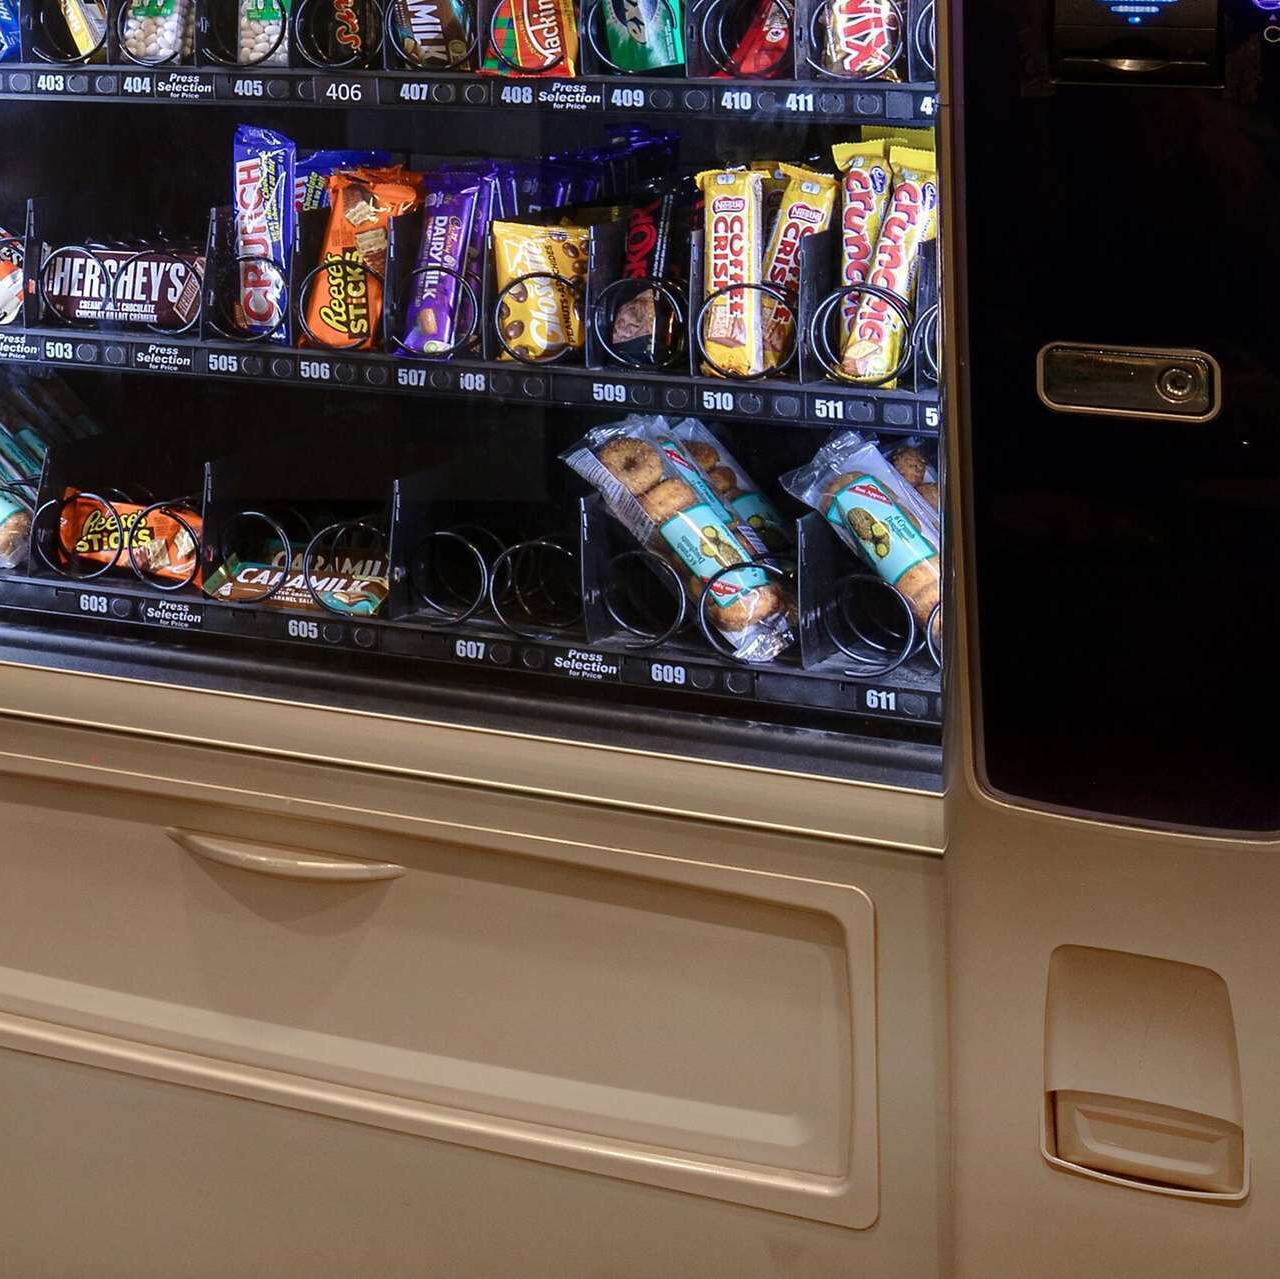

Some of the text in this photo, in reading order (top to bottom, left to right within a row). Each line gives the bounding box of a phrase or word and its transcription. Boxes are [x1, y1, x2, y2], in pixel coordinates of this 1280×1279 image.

[38, 74, 64, 91] 403
[123, 77, 151, 93] 404
[234, 80, 263, 96] 405
[552, 82, 587, 93] Press
[326, 84, 362, 101] 406
[400, 84, 428, 100] 407
[501, 87, 532, 104] 408
[538, 91, 601, 104] Selection
[611, 89, 644, 108] 409
[722, 92, 752, 110] 410
[786, 93, 814, 112] 411
[53, 257, 185, 303] HERSHEY'S
[46, 342, 73, 359] 503
[136, 352, 191, 365] Selection
[148, 344, 179, 355] Press
[209, 354, 238, 372] 505
[301, 361, 330, 379] 506
[398, 368, 426, 386] 507
[593, 383, 626, 402] 509
[703, 392, 734, 411] 510
[815, 400, 843, 419] 511
[85, 510, 146, 533] Reese's
[237, 567, 371, 593] CARAMILK
[80, 596, 107, 613] 603
[159, 600, 190, 612] Press
[146, 608, 201, 623] Selection
[288, 620, 318, 639] 605
[456, 640, 485, 660] 607
[568, 650, 603, 662] Press
[554, 657, 618, 675] Selection
[582, 670, 603, 680] Price
[651, 664, 685, 685] 609
[866, 690, 895, 711] 611
